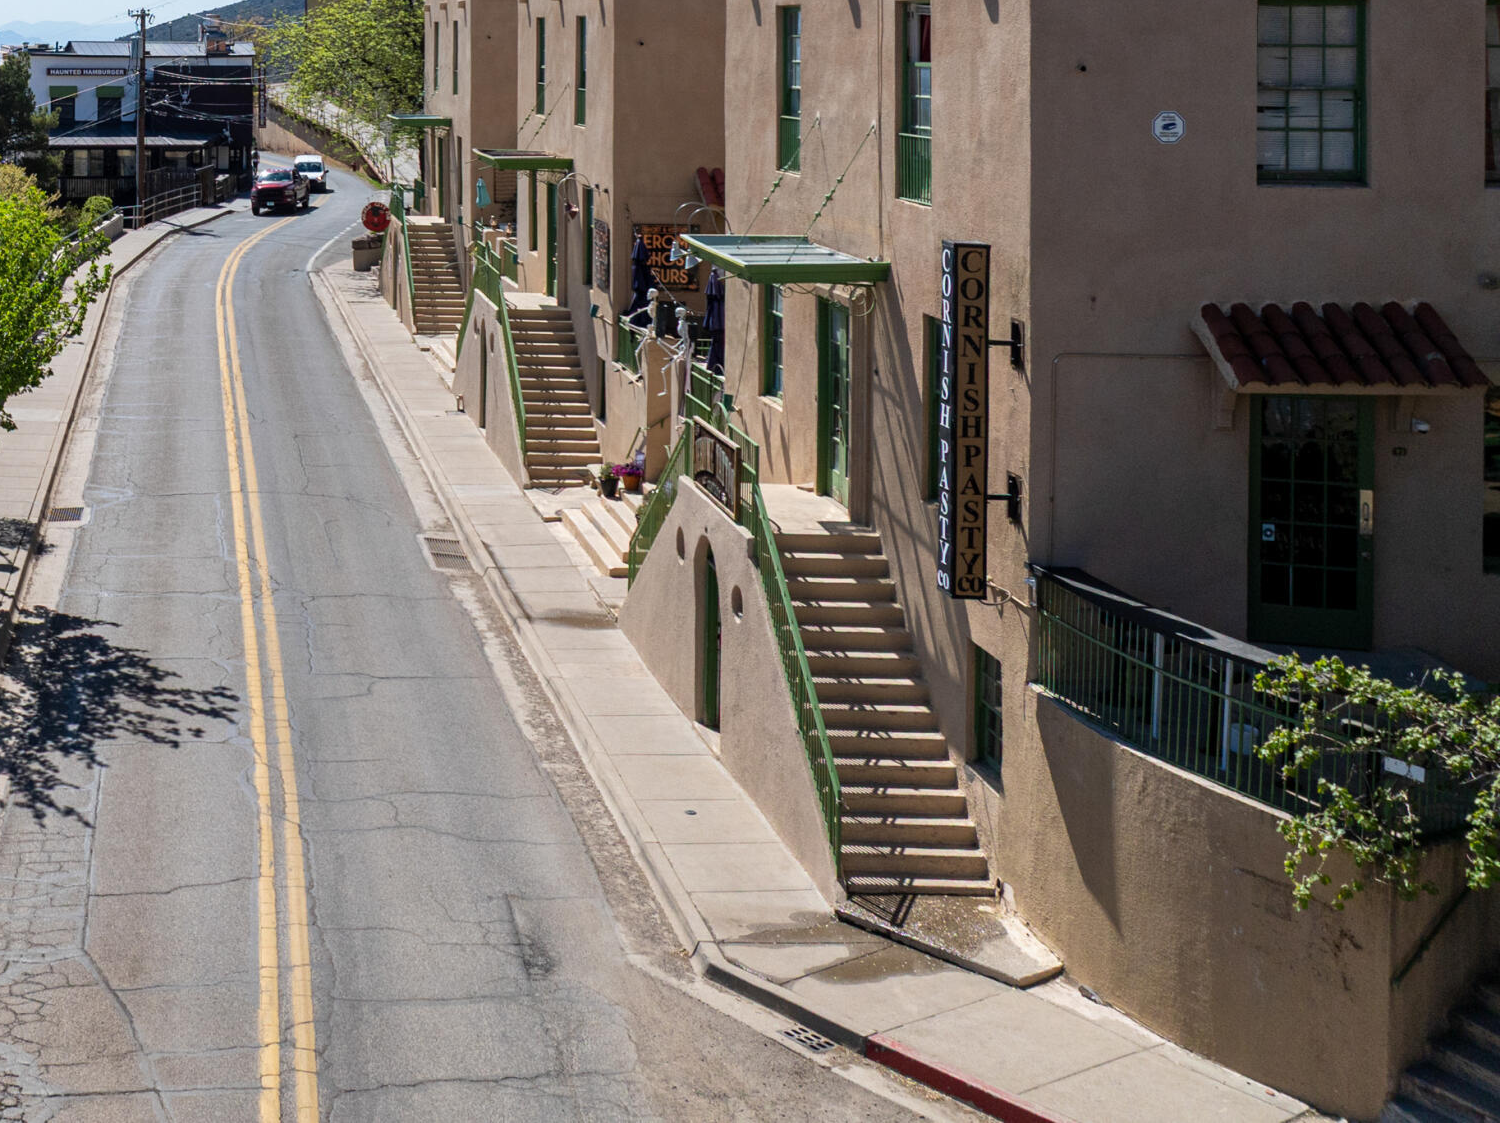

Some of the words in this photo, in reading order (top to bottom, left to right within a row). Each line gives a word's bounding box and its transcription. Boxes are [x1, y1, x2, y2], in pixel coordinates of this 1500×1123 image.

[940, 248, 952, 429] CORNISH
[960, 250, 984, 439] CORNISH
[940, 438, 950, 565] PASTY
[960, 444, 982, 575] PASTY
[937, 569, 950, 590] CO
[957, 577, 984, 593] CO
